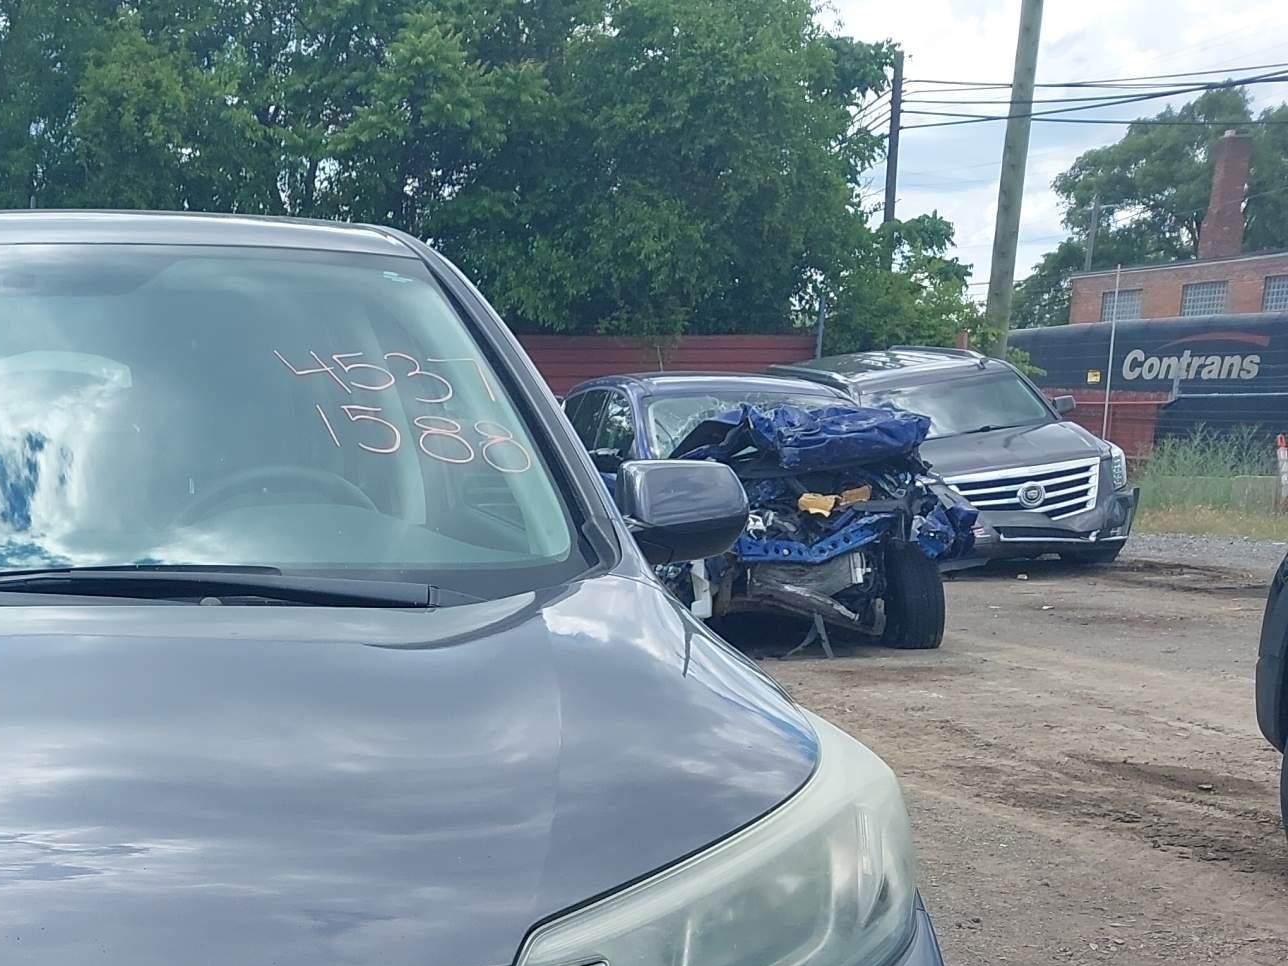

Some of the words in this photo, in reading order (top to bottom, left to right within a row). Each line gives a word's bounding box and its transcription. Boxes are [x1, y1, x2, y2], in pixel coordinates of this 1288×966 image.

[273, 349, 496, 403] 4537
[1121, 348, 1261, 381] Contrans
[315, 404, 532, 474] 1588
